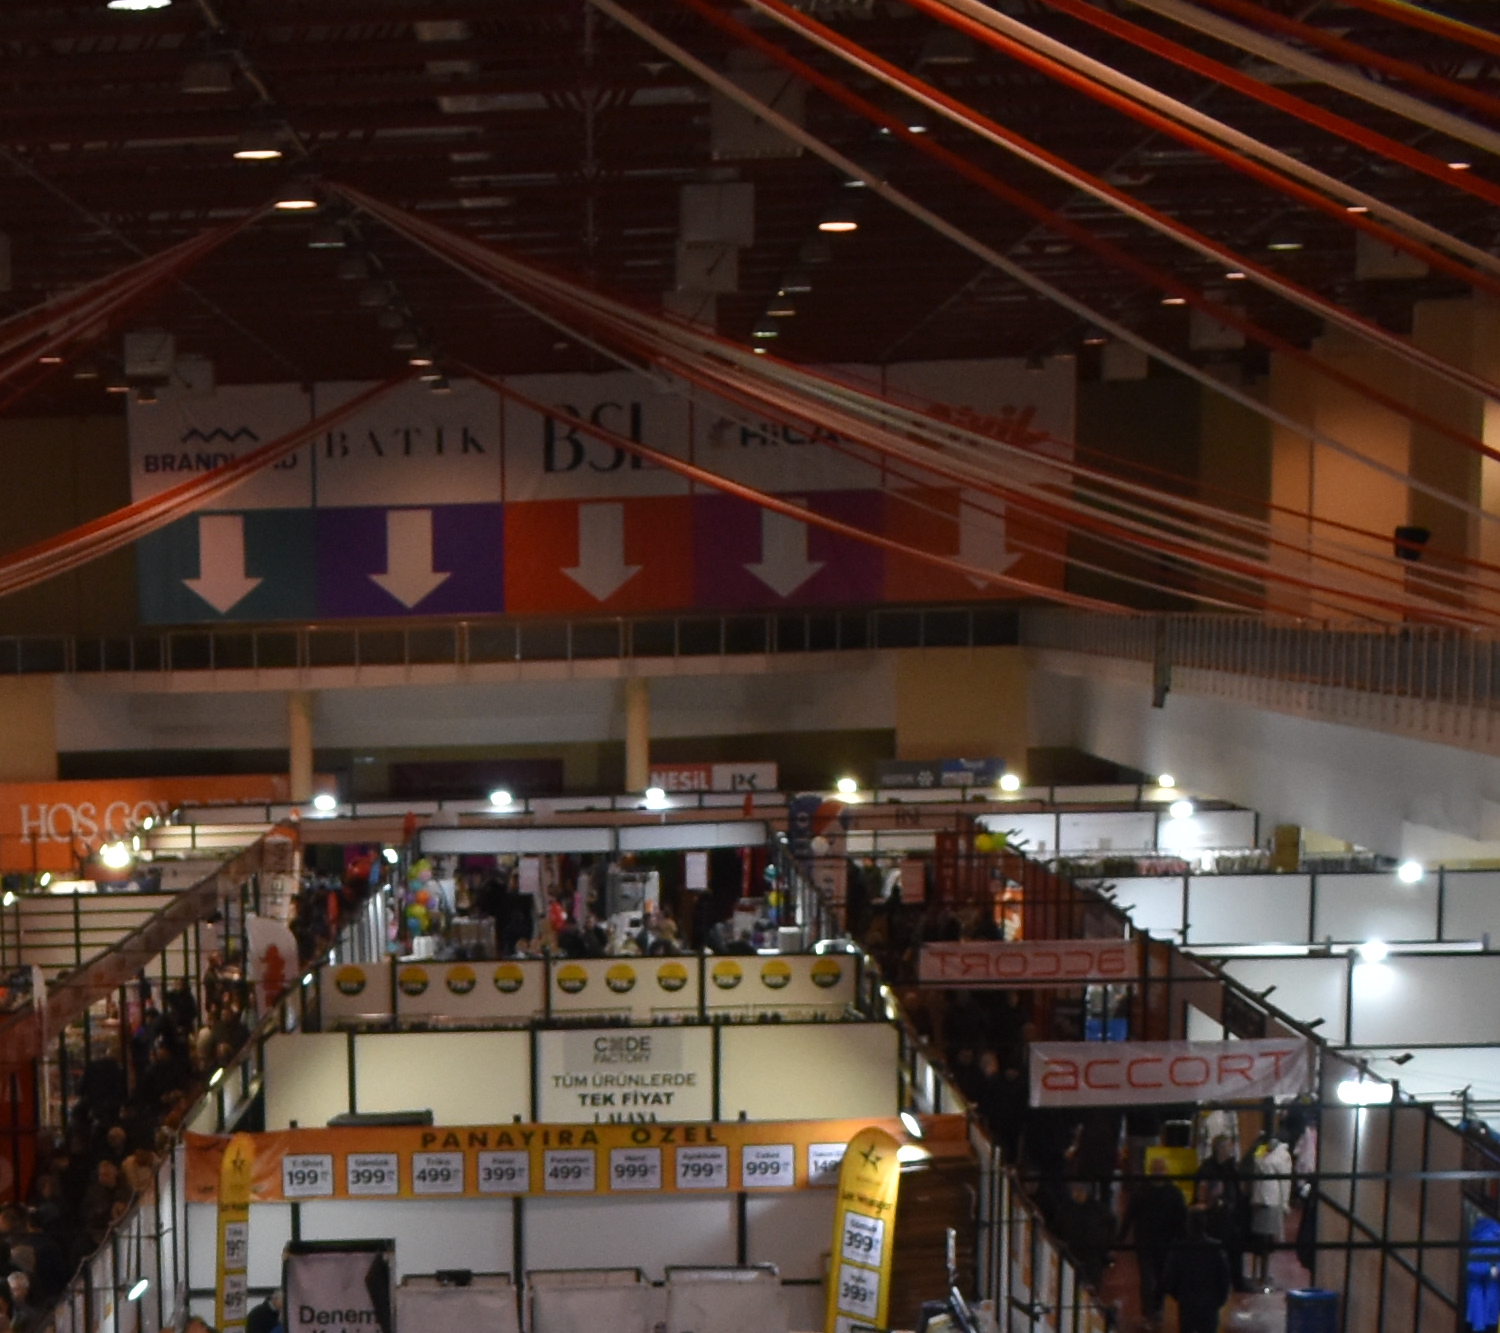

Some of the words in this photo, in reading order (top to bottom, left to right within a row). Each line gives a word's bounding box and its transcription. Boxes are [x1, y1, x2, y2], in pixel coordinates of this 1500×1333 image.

[541, 402, 668, 474] BSL
[553, 1073, 587, 1087] TÜM
[592, 1071, 696, 1086] ÜRÜNLERDE
[579, 1094, 614, 1106] TEK
[622, 1090, 674, 1105] FİYAT
[421, 1127, 599, 1149] PANAYIRA
